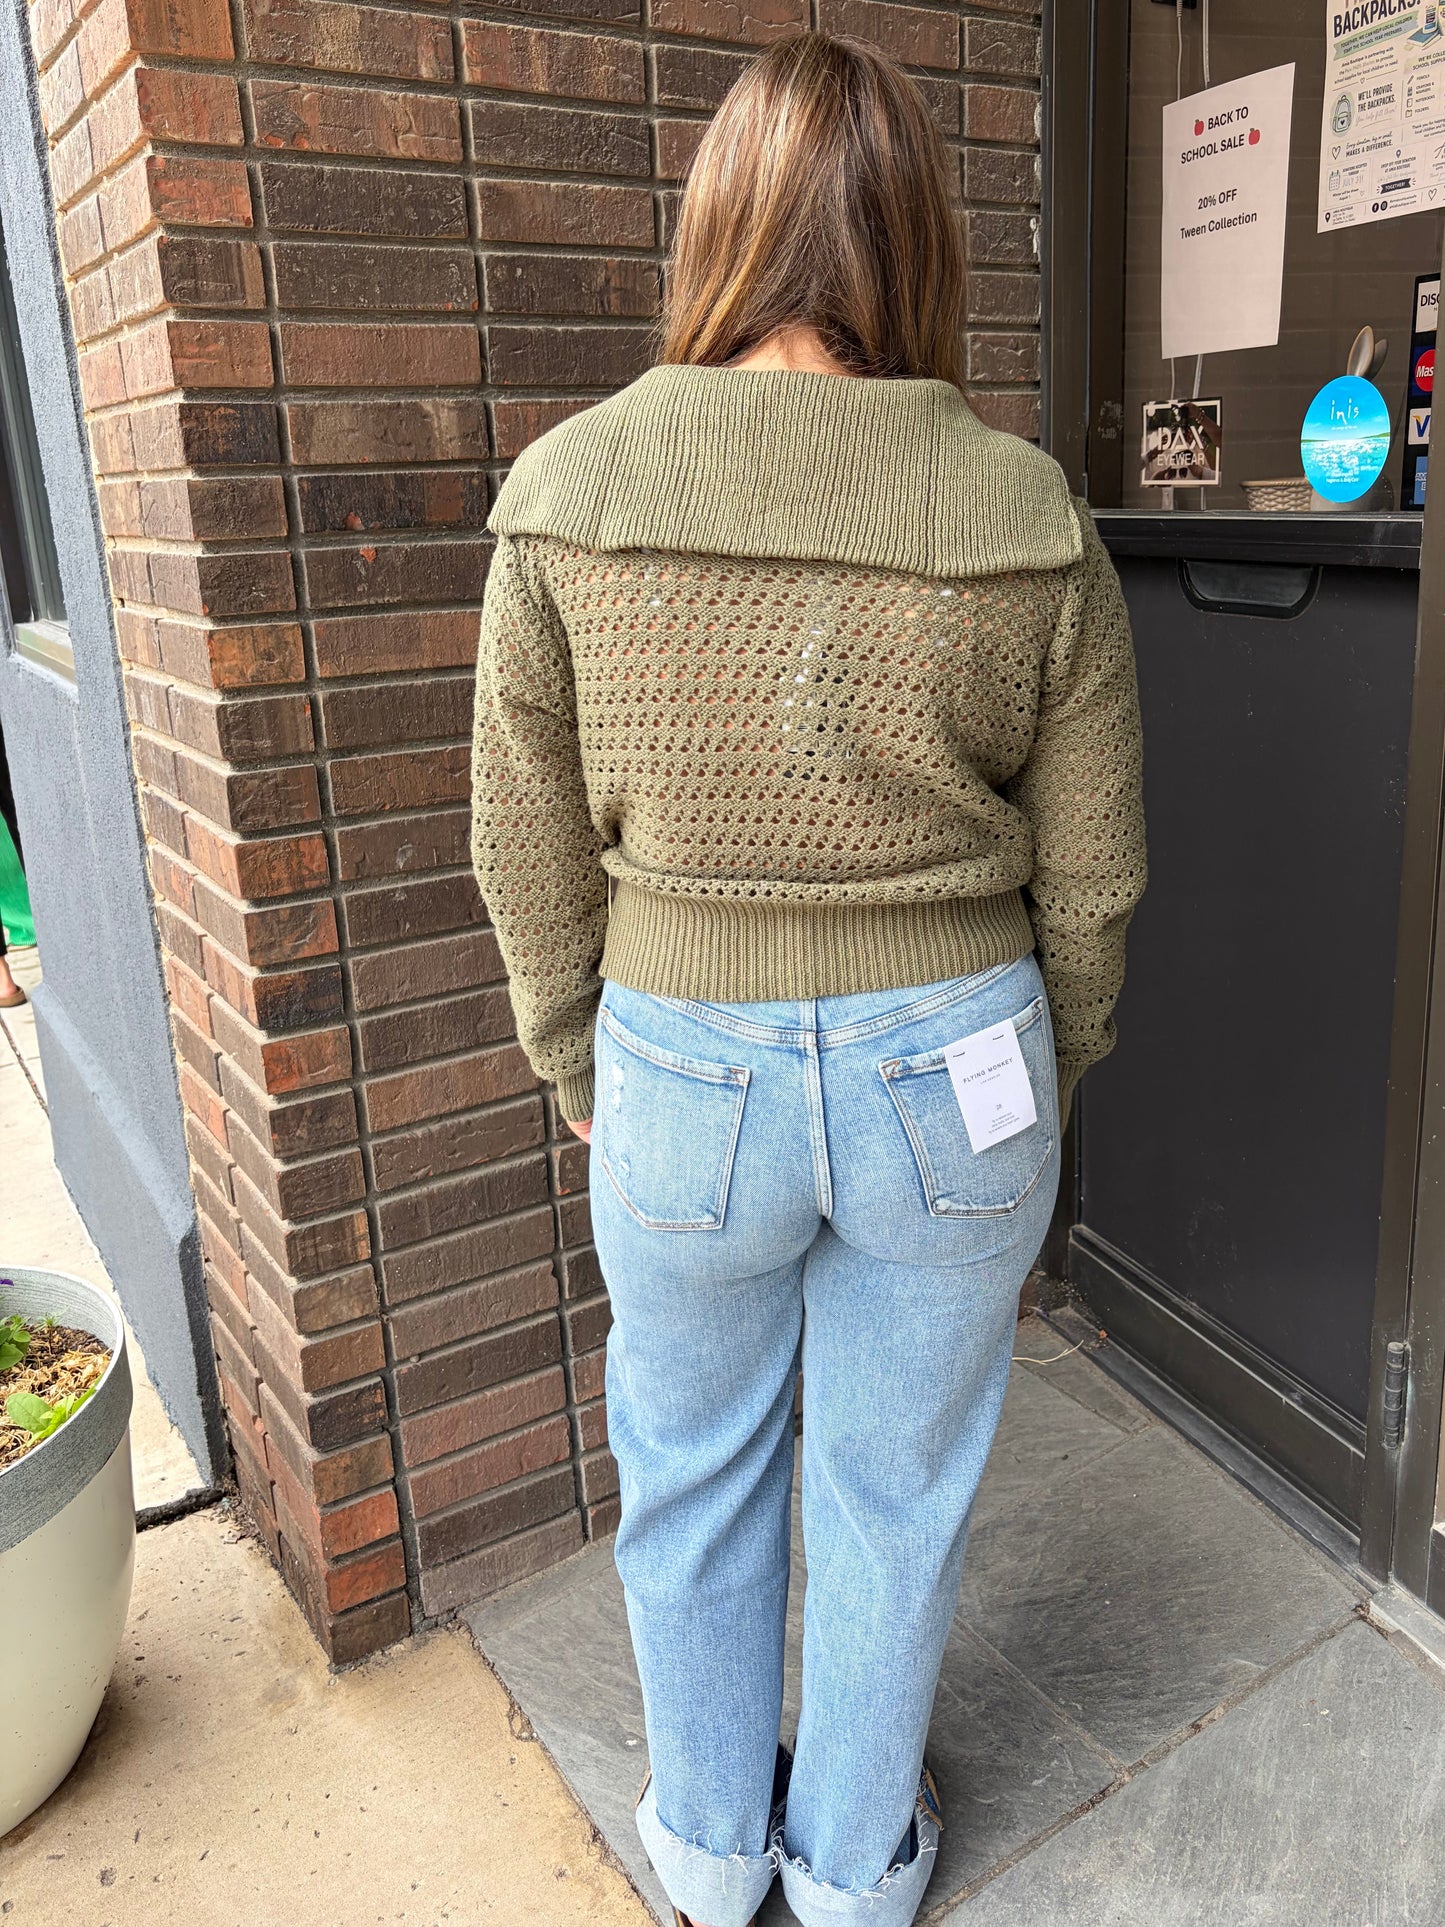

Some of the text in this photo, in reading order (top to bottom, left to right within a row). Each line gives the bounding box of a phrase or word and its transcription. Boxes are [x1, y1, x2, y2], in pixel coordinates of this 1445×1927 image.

[1333, 0, 1421, 38] BACKPACK
[1412, 62, 1430, 70] SCHOOL
[1358, 83, 1393, 101] WE'LL PROVIDE
[1208, 106, 1248, 130] BACK TO
[1358, 102, 1366, 112] THE
[1181, 134, 1244, 164] SCHOOL SALE
[1346, 149, 1360, 158] MAKES
[1198, 188, 1238, 210] 20% OFF
[1180, 212, 1258, 239] Tween Collection
[1330, 398, 1359, 424] inis
[1158, 425, 1204, 451] DAX
[1157, 452, 1205, 466] EYEWEAR
[963, 1070, 986, 1083] FLYING
[988, 1057, 1013, 1072] MONKEY
